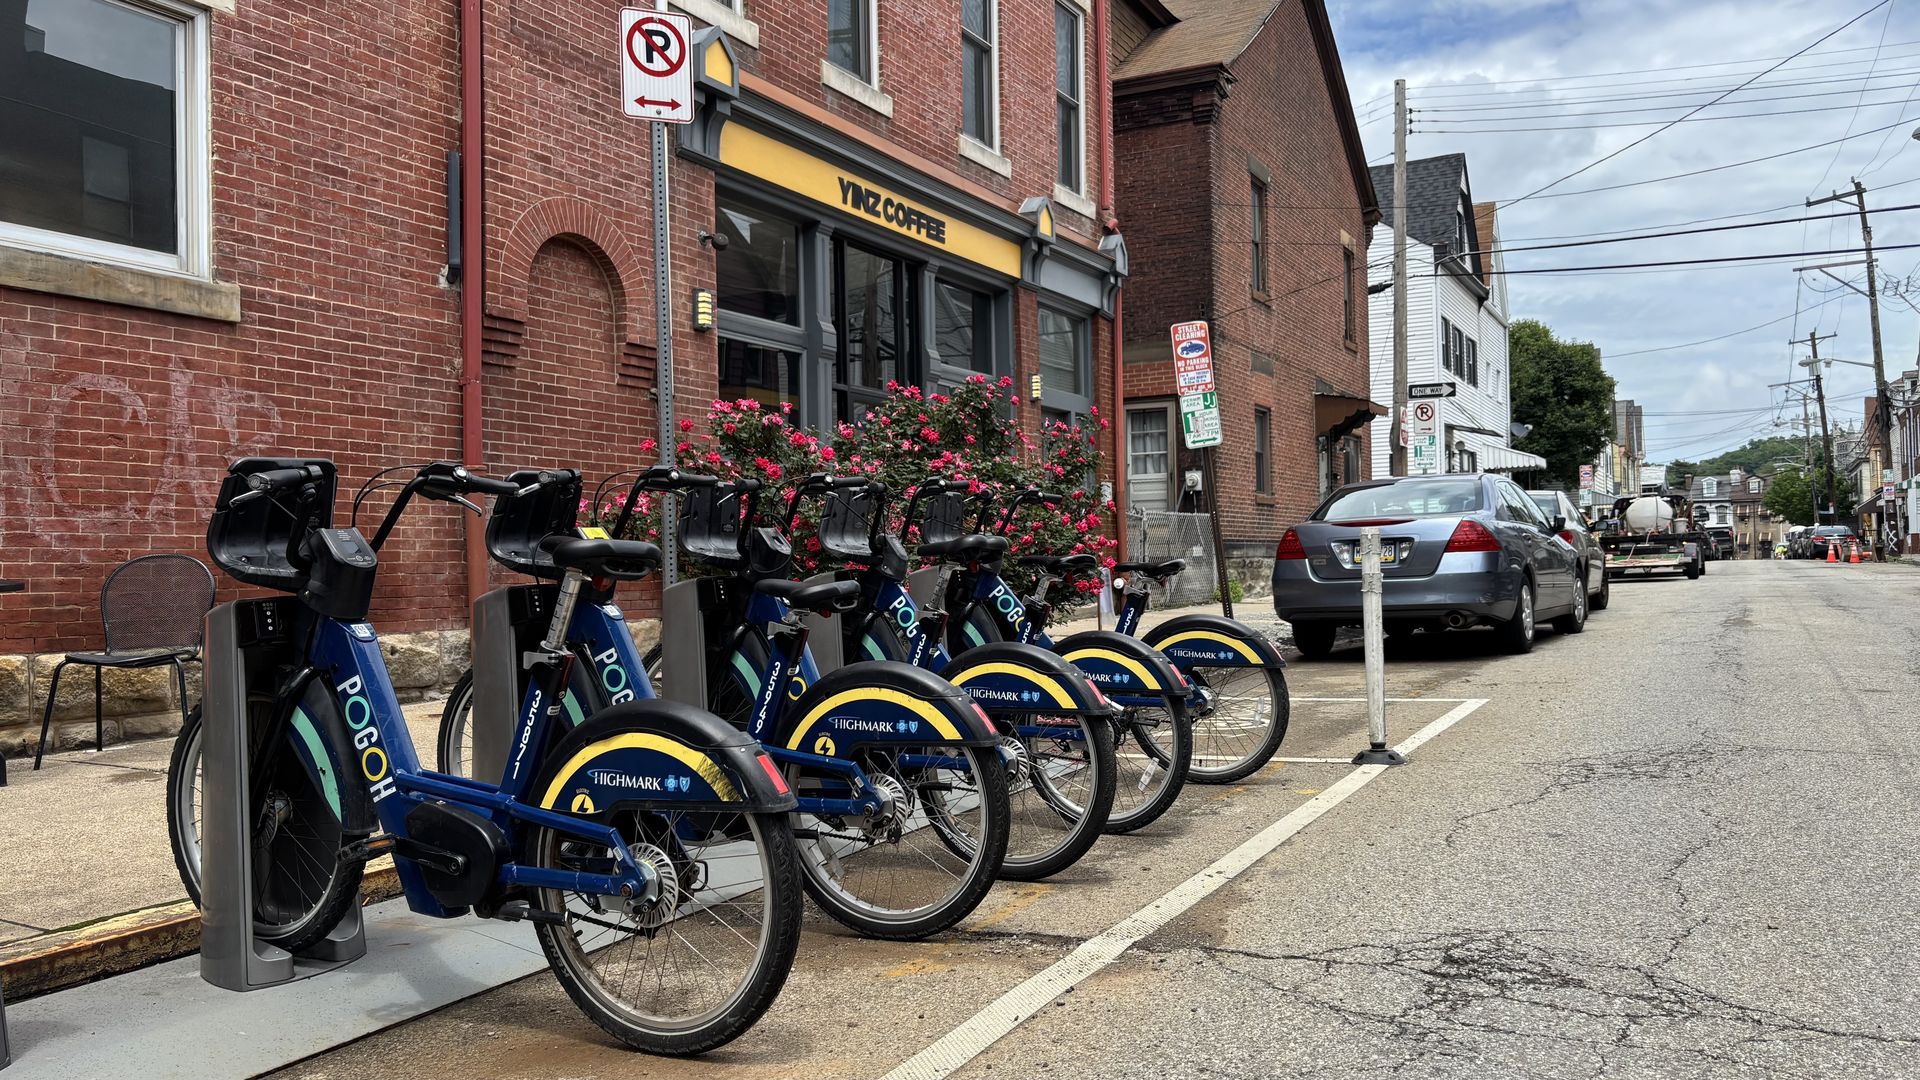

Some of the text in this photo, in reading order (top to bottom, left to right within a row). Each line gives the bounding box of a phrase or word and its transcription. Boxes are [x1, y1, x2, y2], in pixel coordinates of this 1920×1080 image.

[837, 176, 946, 245] YINZ COFFEE
[1175, 329, 1206, 342] CLEANING
[1177, 324, 1201, 334] STREET
[1186, 356, 1209, 367] PARKING
[1204, 393, 1216, 408] JJ
[889, 595, 920, 638] POG
[988, 584, 1024, 632] POG
[1173, 649, 1217, 660] HIGHMARK
[595, 647, 634, 706] POG
[1086, 672, 1112, 683] MARK
[755, 661, 781, 734] 35949
[969, 687, 1019, 701] HIGHMARK
[834, 717, 894, 733] HIGHMARK
[336, 674, 397, 804] POGOH
[512, 689, 542, 780] 35871
[594, 771, 662, 791] HIGHMARK
